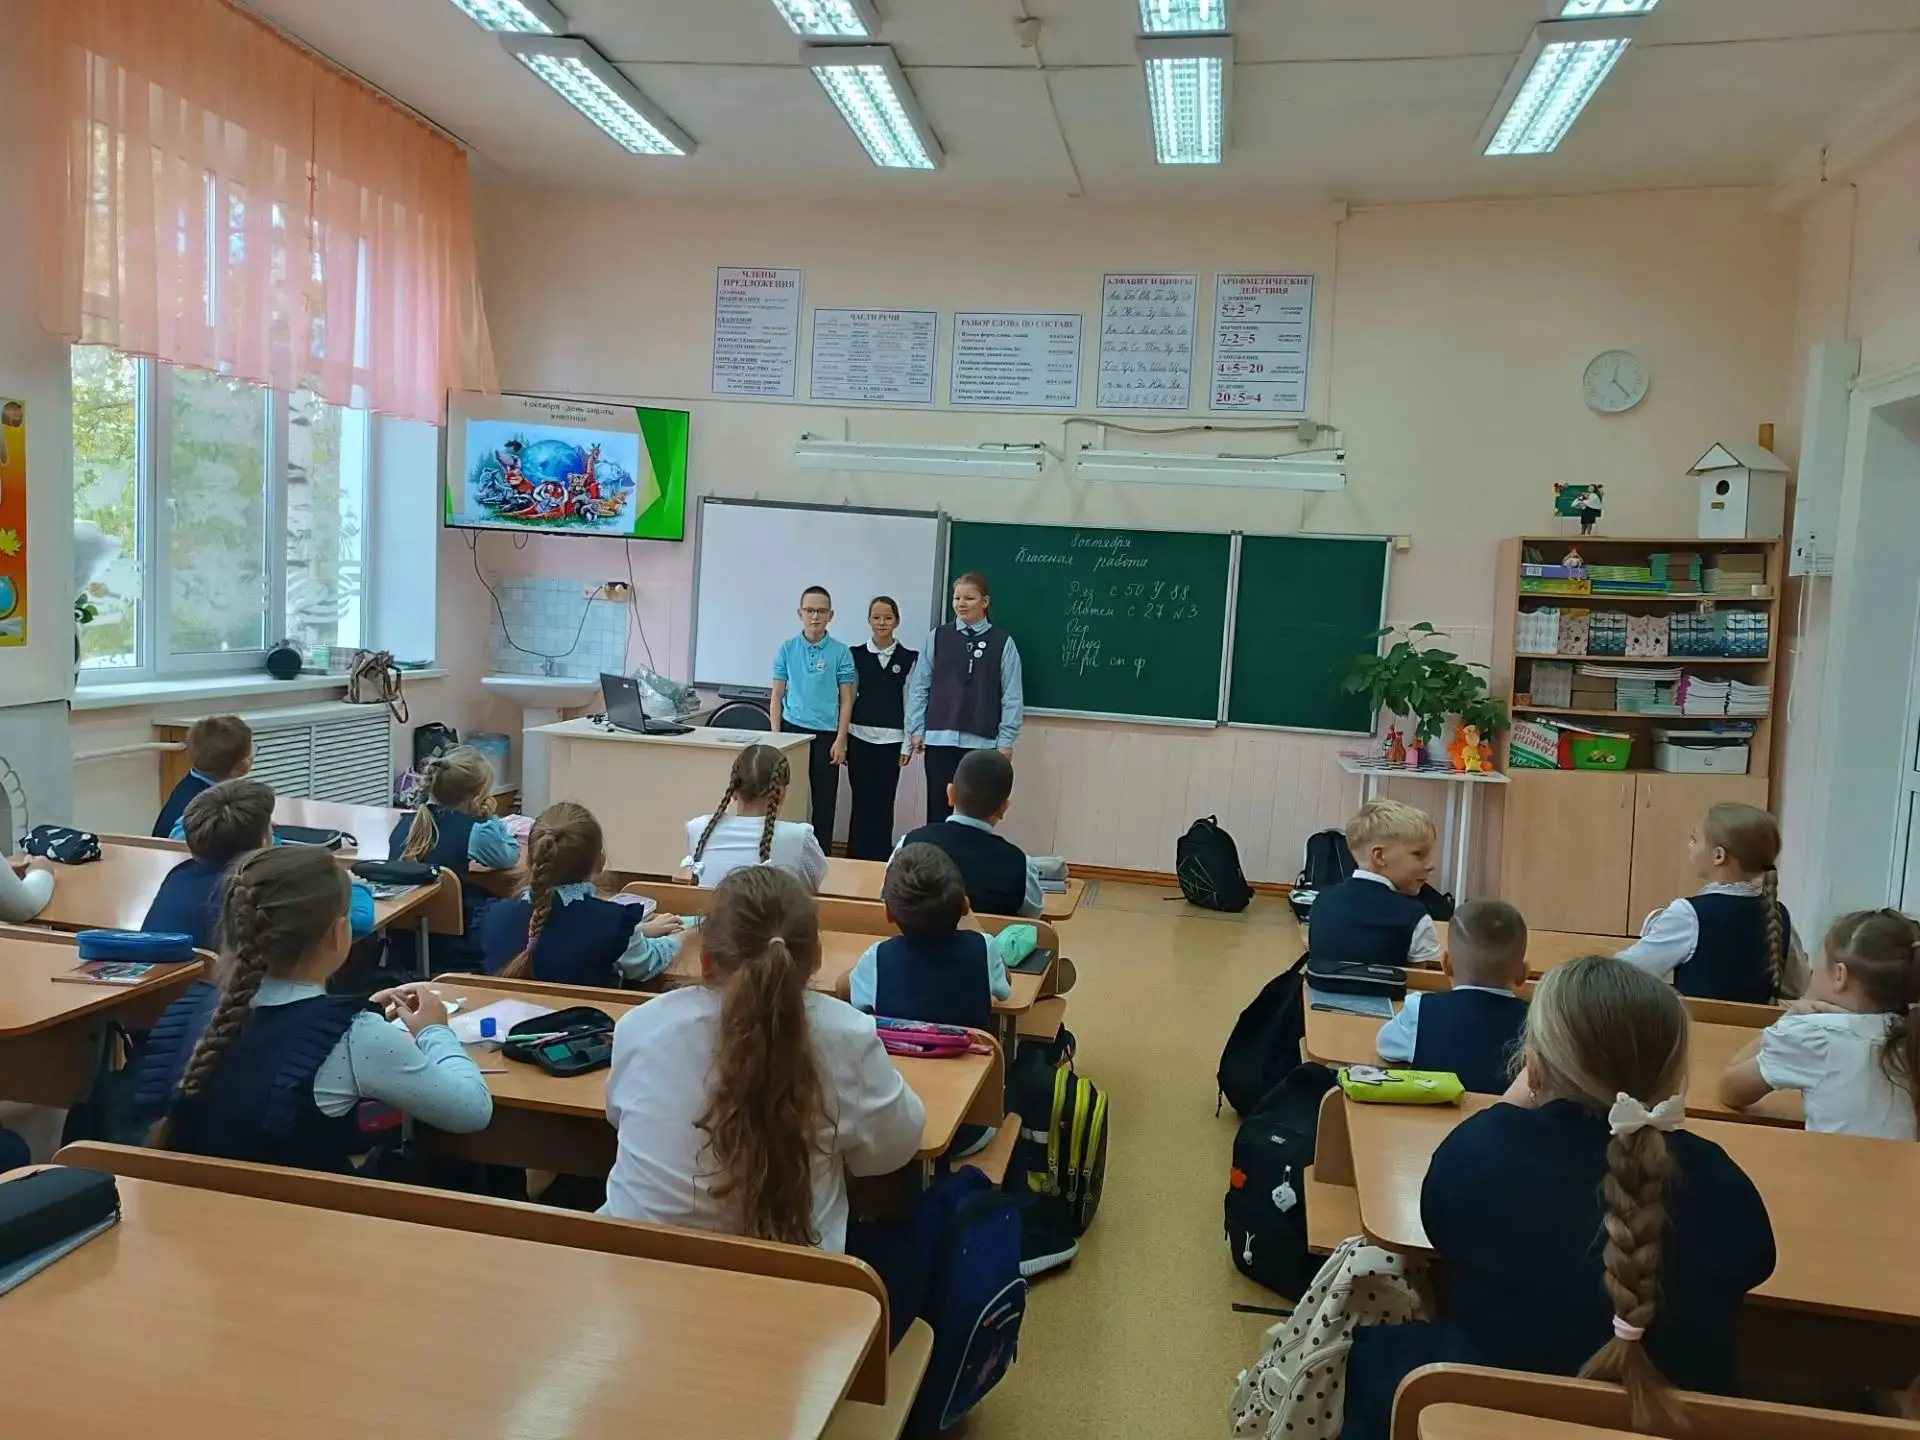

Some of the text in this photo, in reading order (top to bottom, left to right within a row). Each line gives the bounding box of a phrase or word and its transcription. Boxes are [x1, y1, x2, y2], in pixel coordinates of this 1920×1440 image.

[742, 271, 776, 279] ЧЛЕНЫ
[723, 279, 795, 288] ПРЕДЛОЖЕНИЯ
[1221, 277, 1309, 285] АРИФМЕТИЧЕСКИЕ
[1240, 287, 1289, 295] ДЕЙСТВИЯ
[1221, 304, 1262, 315] 5+2=7
[961, 319, 989, 327] РАЗБОР
[1036, 320, 1073, 328] СОСТАВУ
[1220, 333, 1256, 344] 7-2=5
[529, 402, 560, 411] октября
[566, 405, 585, 413] день
[1015, 547, 1149, 572] Классная работа
[1124, 583, 1144, 596] 50
[1170, 585, 1190, 600] 88
[1143, 603, 1164, 619] 27
[1188, 605, 1198, 619] 3
[1067, 618, 1090, 638] Окр
[1062, 634, 1100, 657] Труд
